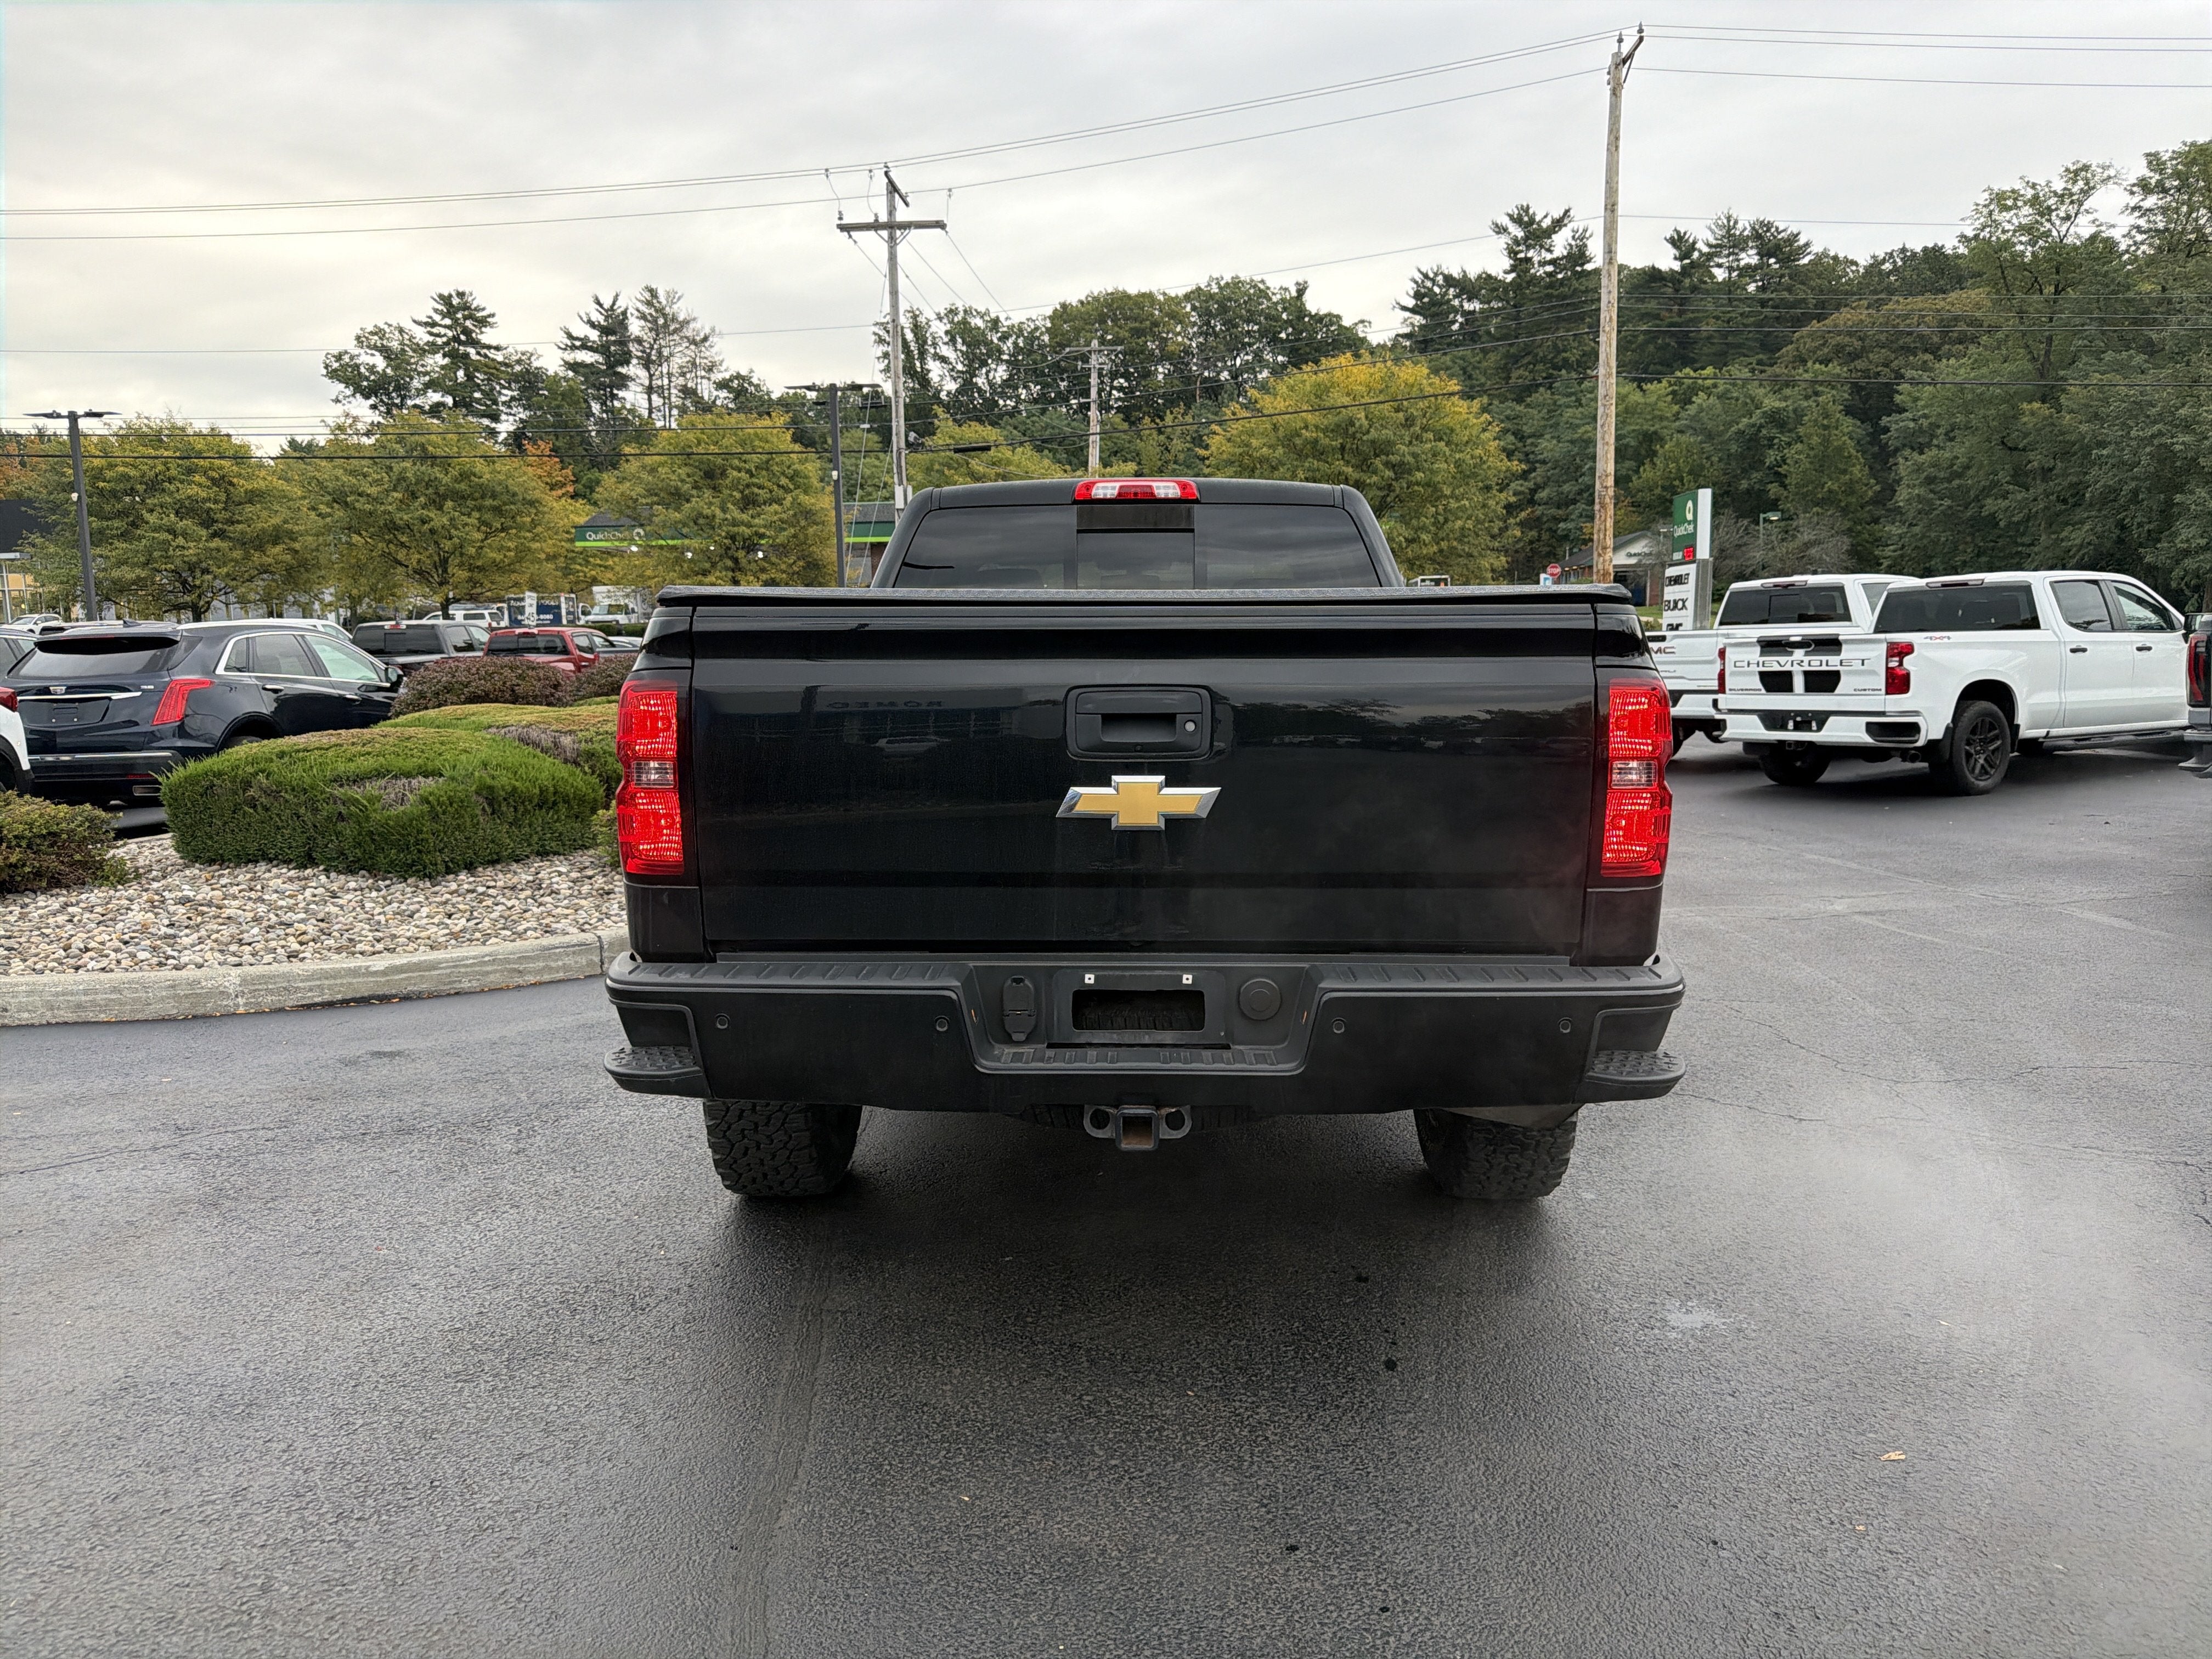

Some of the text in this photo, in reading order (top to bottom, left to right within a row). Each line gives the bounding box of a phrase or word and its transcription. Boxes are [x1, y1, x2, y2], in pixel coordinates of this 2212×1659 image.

[1663, 597, 1689, 612] BUICK
[526, 612, 535, 623] 45
[1650, 646, 1677, 654] MC
[1734, 658, 1871, 668] CHEVROLET
